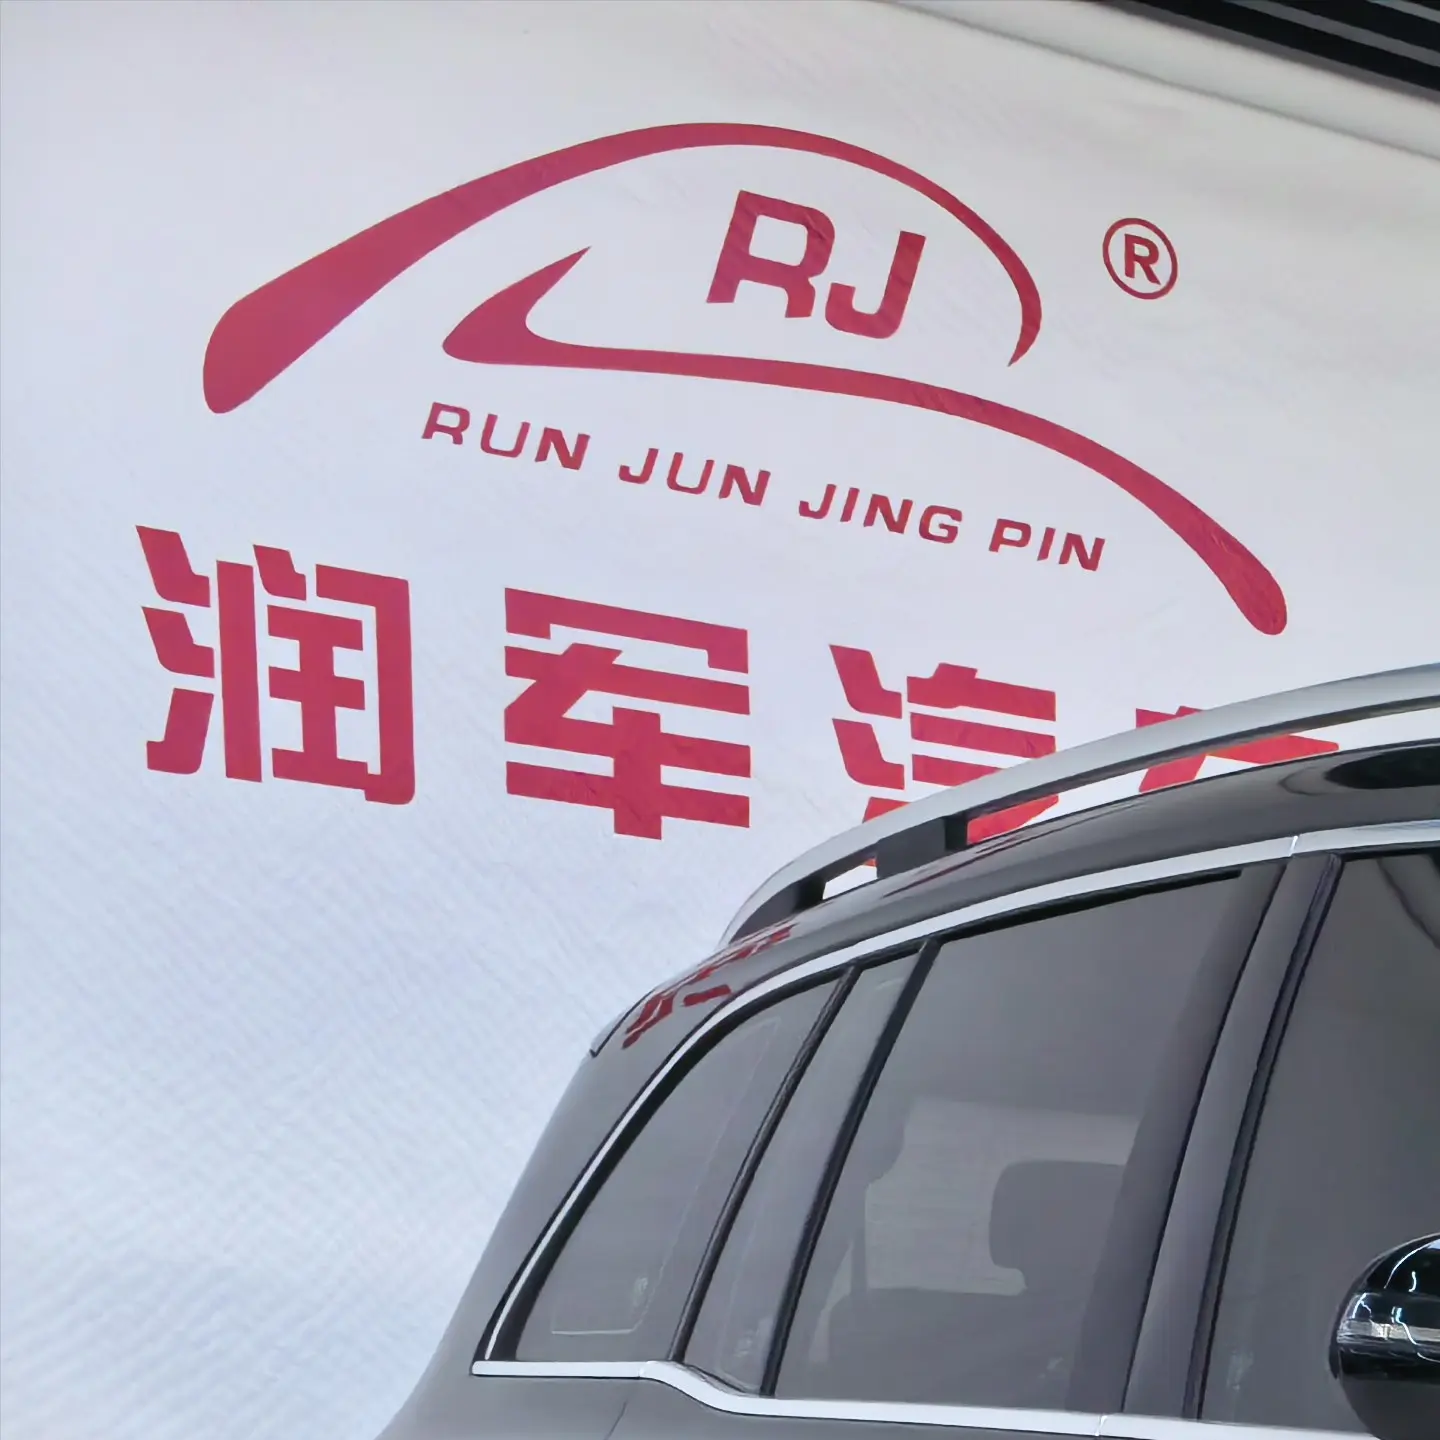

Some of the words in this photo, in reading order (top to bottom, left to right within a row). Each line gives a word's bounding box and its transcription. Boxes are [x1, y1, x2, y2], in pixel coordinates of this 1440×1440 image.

[706, 190, 926, 340] RJ
[421, 401, 590, 470] RUN
[618, 448, 771, 506] JUN
[799, 484, 963, 545] JING
[989, 519, 1106, 572] PIN
